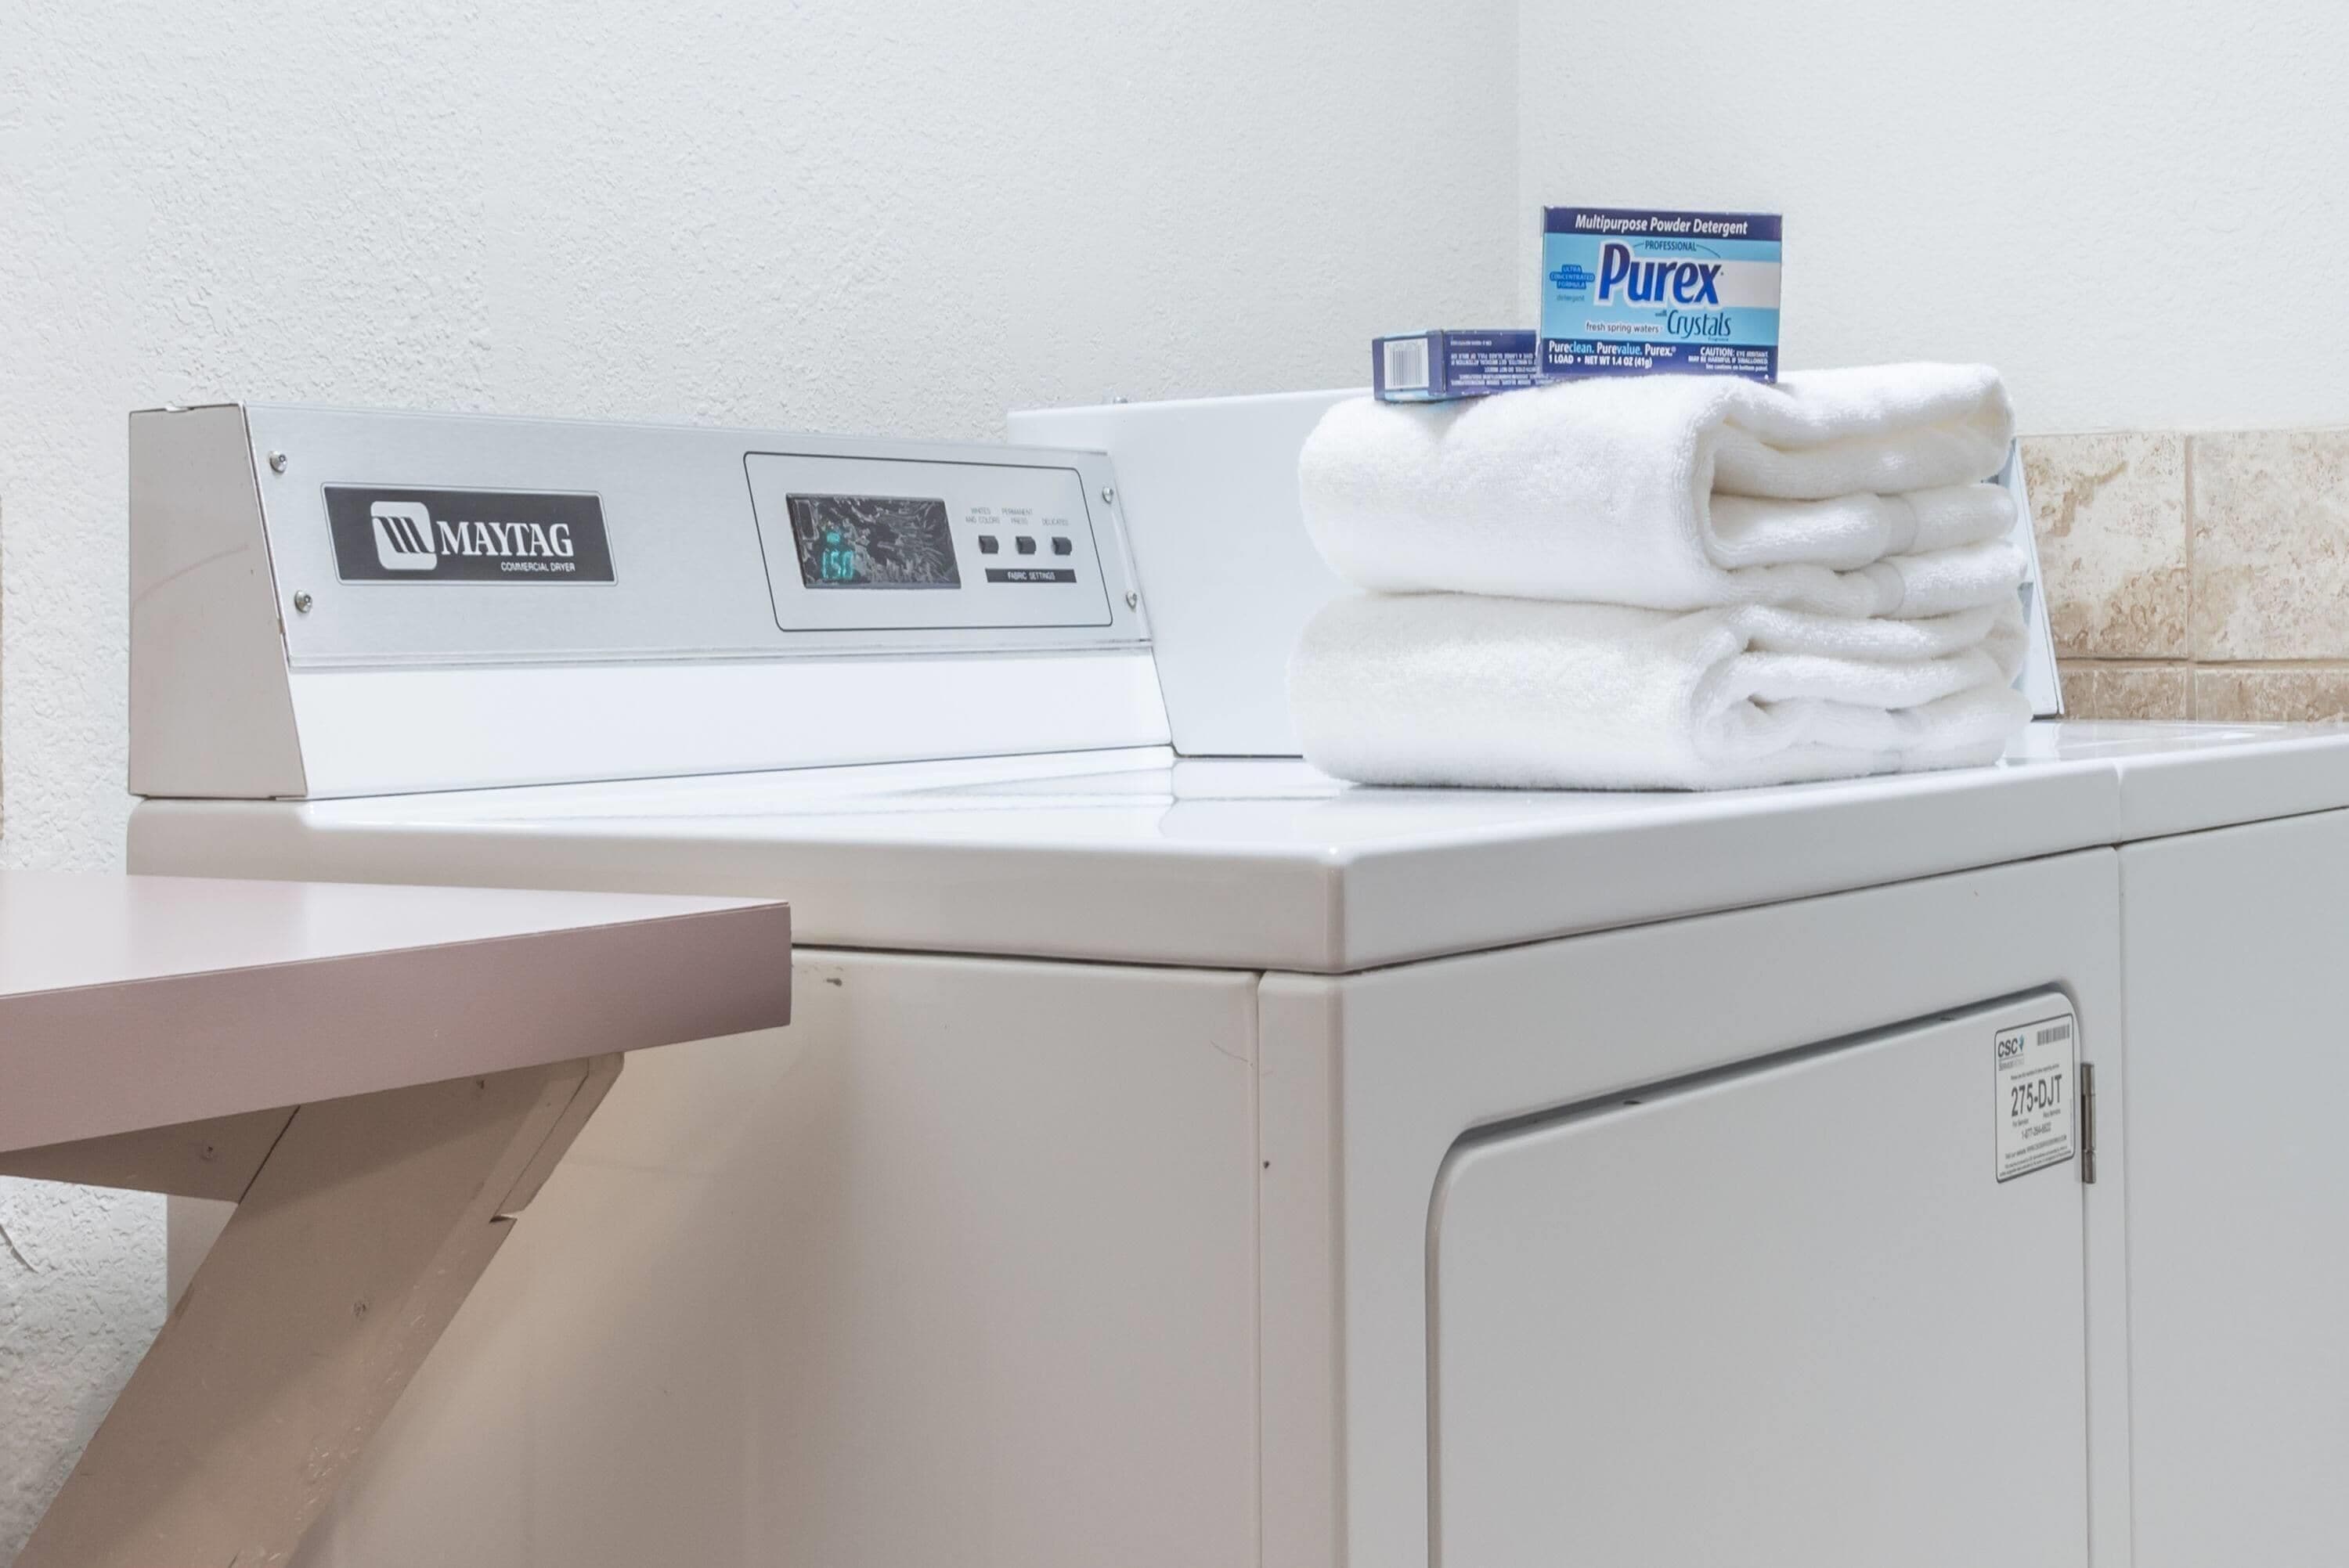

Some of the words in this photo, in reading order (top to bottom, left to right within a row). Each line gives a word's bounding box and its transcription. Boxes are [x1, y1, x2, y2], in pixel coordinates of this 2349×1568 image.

[1575, 214, 1648, 233] Multipurpose
[1650, 216, 1691, 232] Powder
[1692, 218, 1748, 237] Detergent
[1644, 240, 1697, 251] PROFESSIONAL
[1598, 242, 1723, 306] Purex
[1586, 321, 1606, 331] fresh
[1607, 323, 1633, 334] spring
[1633, 325, 1659, 334] waters
[1667, 308, 1732, 339] Crystals
[1549, 340, 1594, 355] Pureclean.
[1597, 341, 1643, 356] Purevalue.
[1700, 346, 1735, 357] CAUTION:
[1549, 354, 1553, 364] 1
[1554, 355, 1574, 365] LOAD
[1584, 355, 1598, 366] NET
[1599, 356, 1611, 366] WT
[1612, 356, 1622, 366] 1.4
[1623, 357, 1633, 366] OZ
[1634, 356, 1653, 369] (41g)
[436, 521, 575, 557] MAYTAG
[501, 561, 550, 572] COMMERCIAL
[550, 562, 576, 572] DRYER
[1007, 571, 1027, 580] FABRIC
[1028, 571, 1056, 580] SETTINGS
[1997, 1037, 2019, 1058] CSC
[2011, 1074, 2062, 1117] 275-DJT
